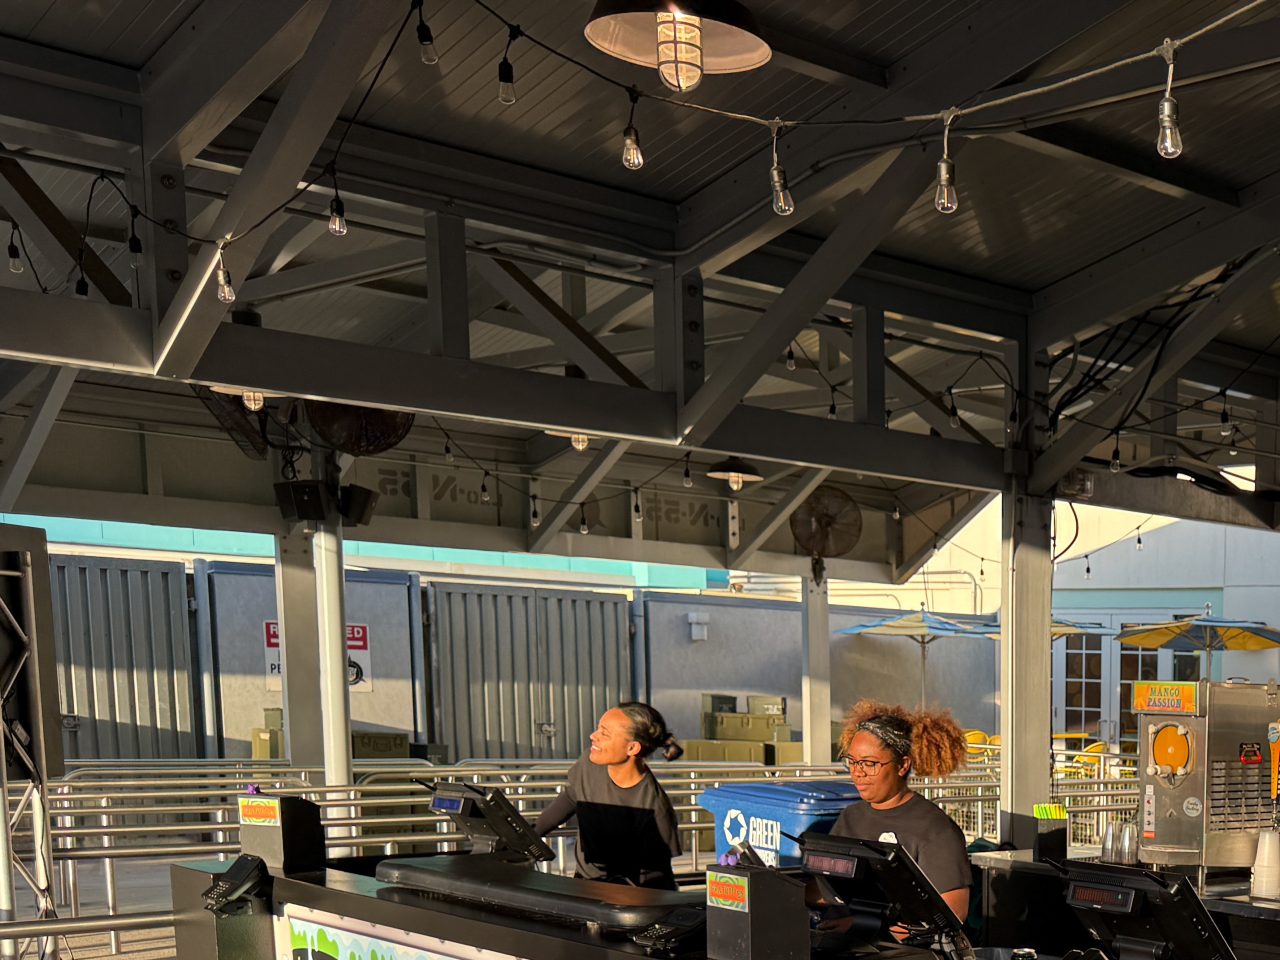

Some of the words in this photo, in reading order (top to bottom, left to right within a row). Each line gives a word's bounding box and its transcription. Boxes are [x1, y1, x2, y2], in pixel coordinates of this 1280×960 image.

[1150, 687, 1180, 697] MANGO
[1147, 698, 1182, 708] PASSION
[749, 816, 781, 851] GREEN
